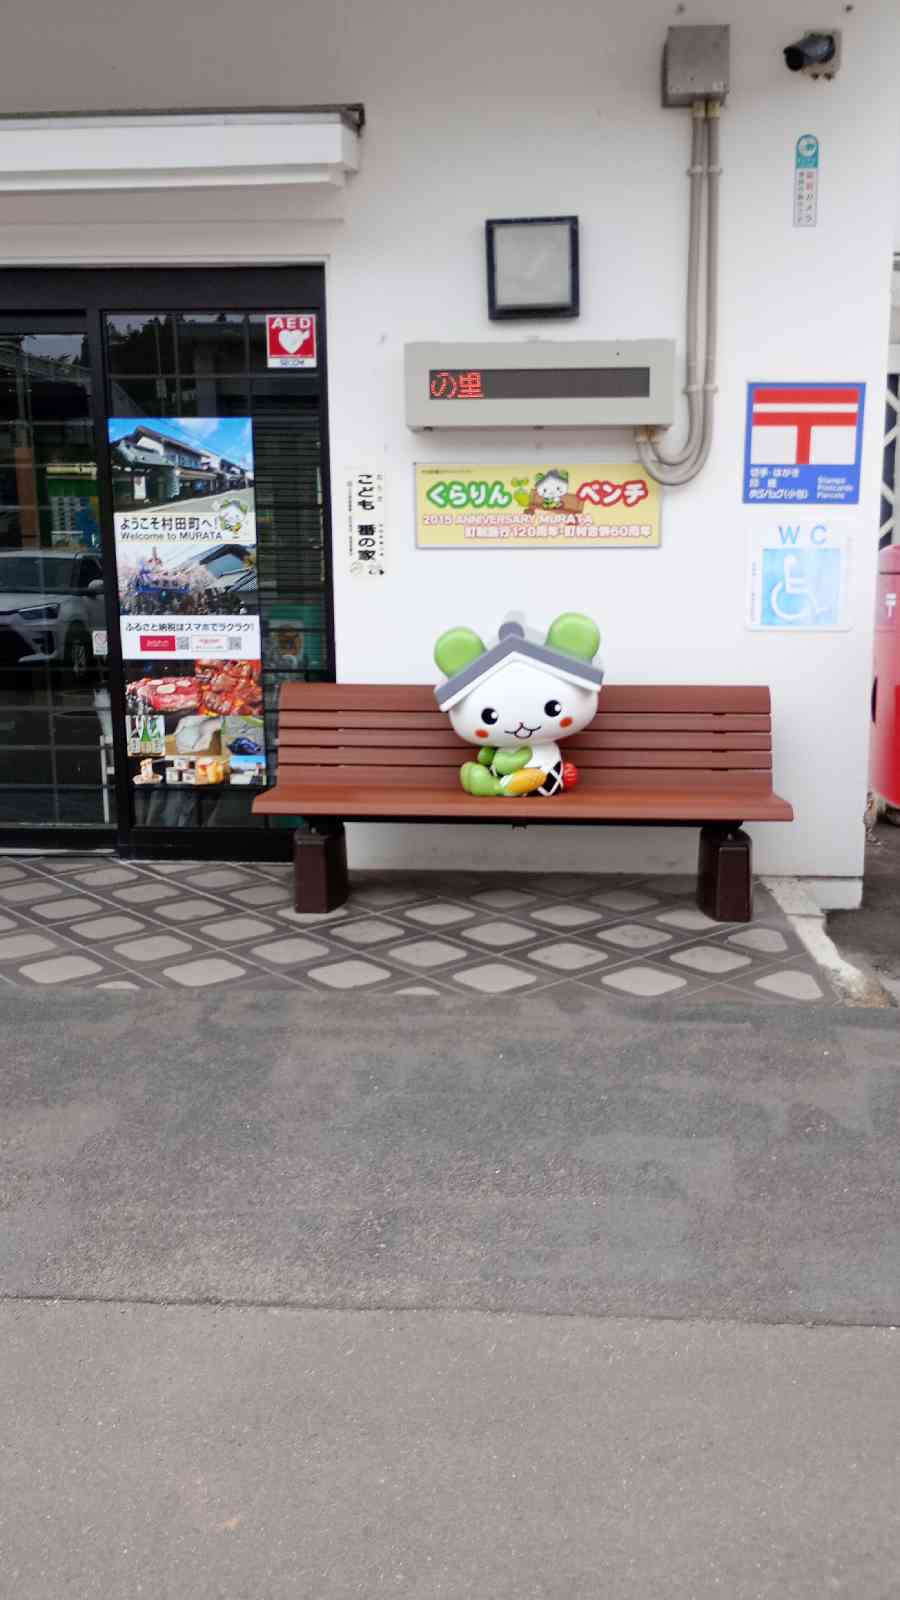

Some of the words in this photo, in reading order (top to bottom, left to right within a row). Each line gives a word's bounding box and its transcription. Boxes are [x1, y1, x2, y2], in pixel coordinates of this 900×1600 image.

[271, 317, 311, 329] AED
[427, 480, 513, 509] くらりん
[423, 514, 453, 526] 2015
[455, 513, 535, 526] ANNIVERSARY
[540, 513, 593, 526] MURATA
[121, 531, 164, 540] Welcome
[167, 531, 177, 540] to
[180, 531, 222, 540] MURATA
